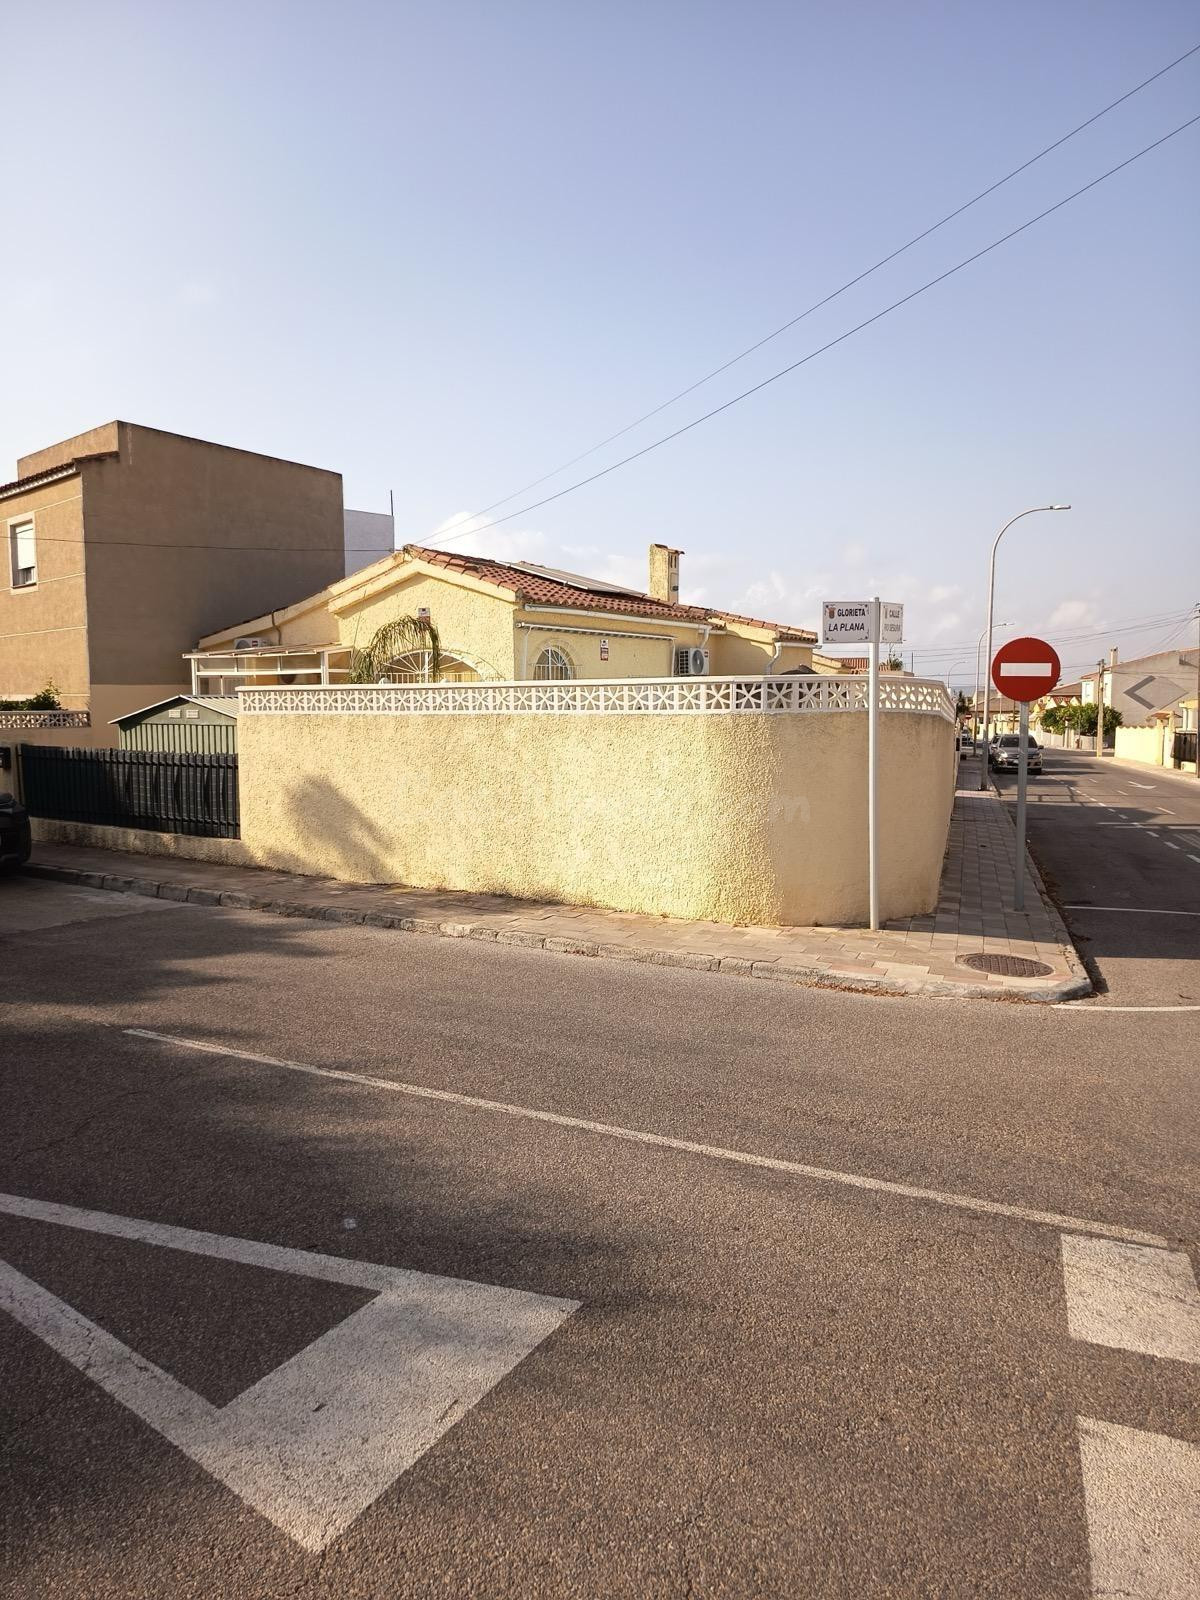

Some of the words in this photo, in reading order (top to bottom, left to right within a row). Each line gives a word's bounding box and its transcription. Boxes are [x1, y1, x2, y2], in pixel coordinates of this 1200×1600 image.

[837, 608, 866, 617] GLORIETA
[889, 609, 900, 618] CALLE
[828, 623, 839, 632] LA
[840, 622, 865, 632] PLANA
